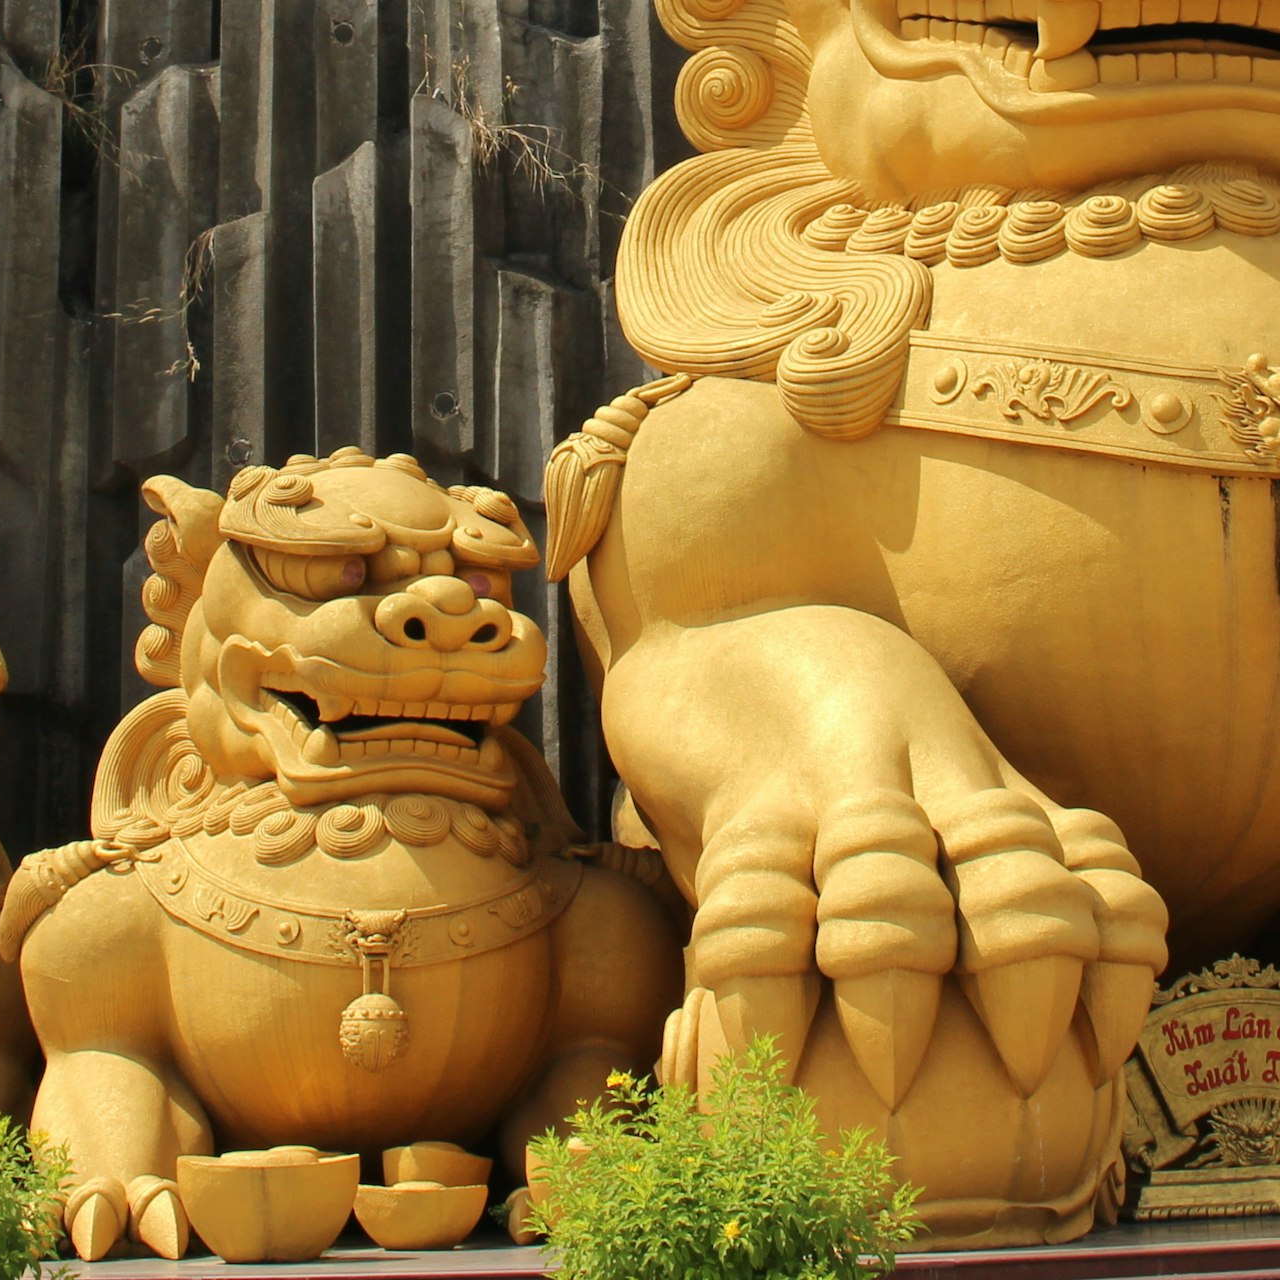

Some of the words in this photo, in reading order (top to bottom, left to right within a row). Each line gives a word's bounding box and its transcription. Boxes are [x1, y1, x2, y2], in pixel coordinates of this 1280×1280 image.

[1162, 1019, 1215, 1056] Kim
[1222, 1007, 1271, 1040] Lân
[1184, 1050, 1249, 1095] Xuất
